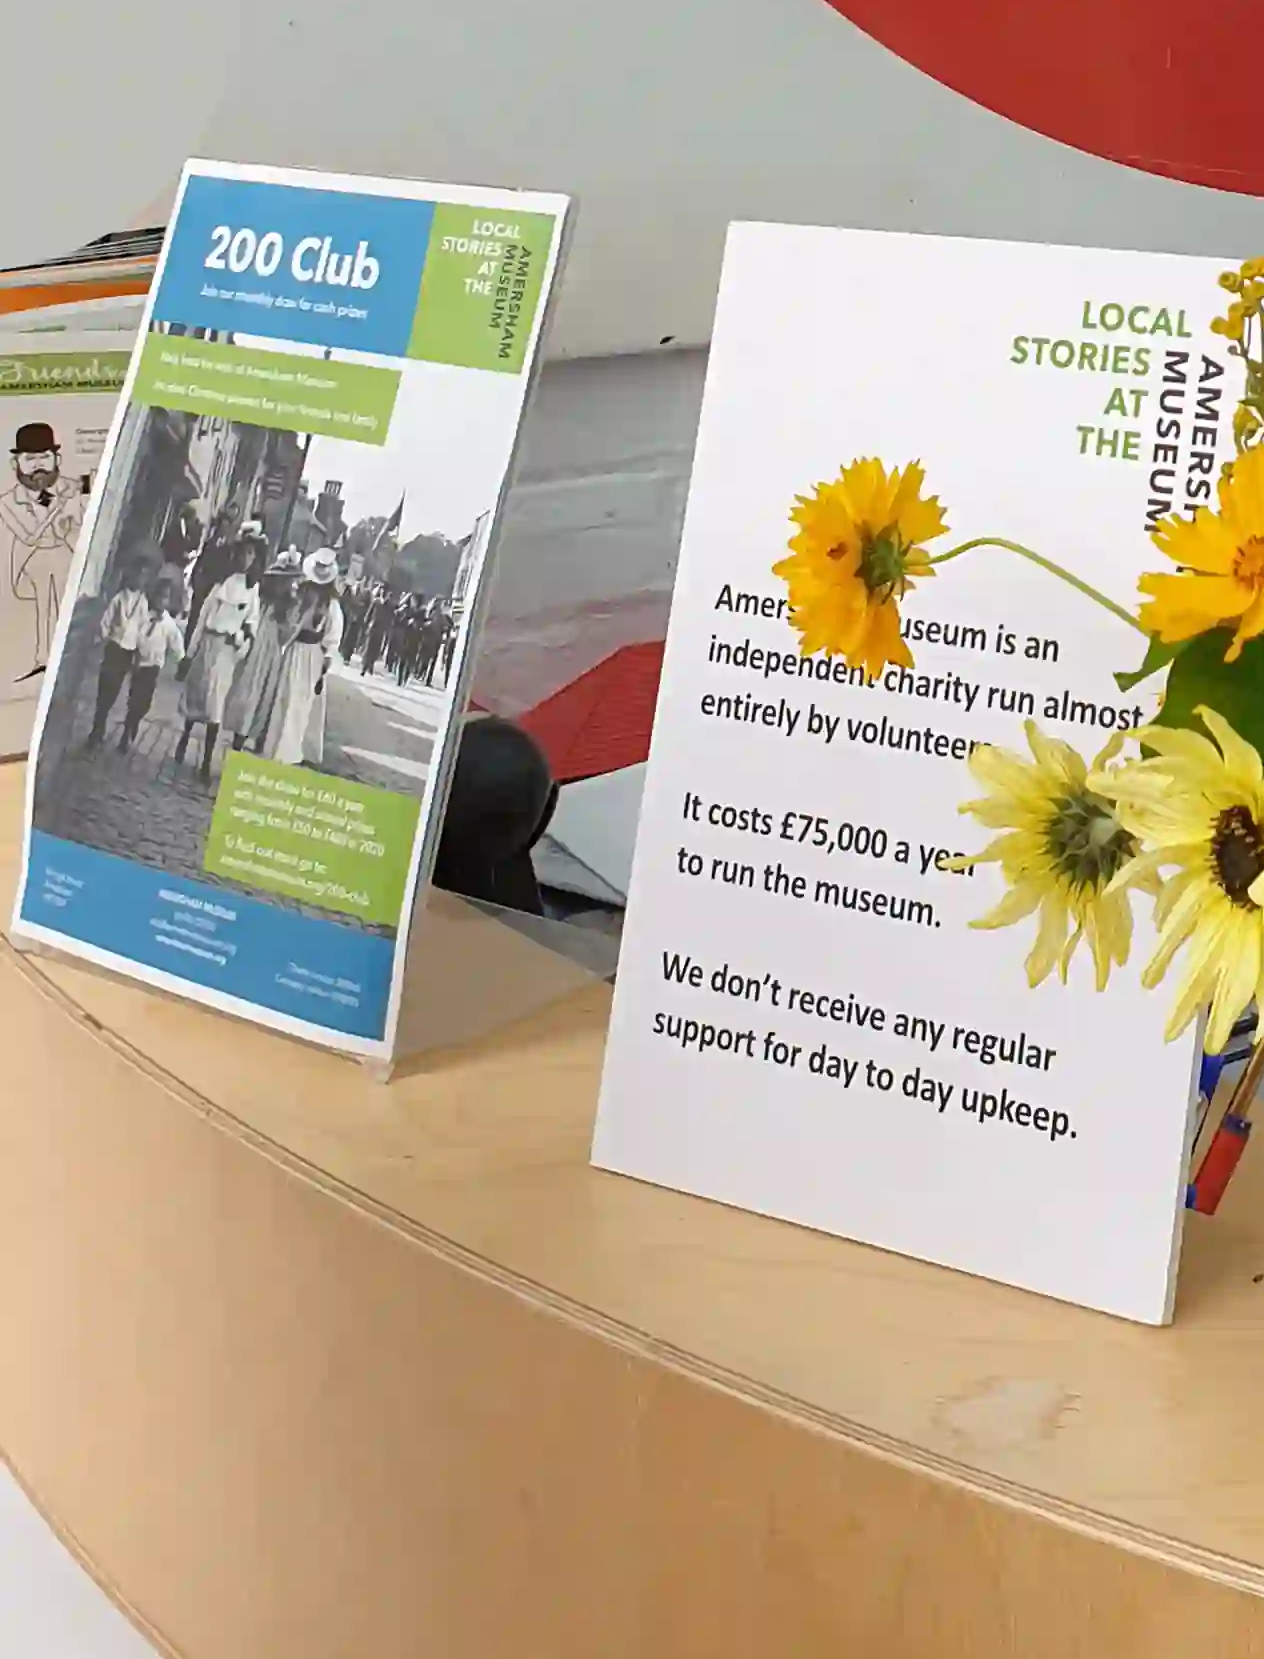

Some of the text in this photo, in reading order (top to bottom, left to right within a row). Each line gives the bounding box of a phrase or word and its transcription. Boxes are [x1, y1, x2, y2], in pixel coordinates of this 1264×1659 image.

[204, 225, 380, 290] 200 Club
[441, 236, 503, 257] STORIES
[472, 219, 521, 239] LOCAL
[462, 278, 494, 295] THE
[477, 261, 499, 276] AT
[488, 244, 518, 329] MUSEUM
[498, 245, 533, 359] AMERSHAM
[1081, 300, 1193, 338] LOCAL
[1010, 335, 1152, 376] STORIES
[1103, 388, 1149, 418] AT
[1076, 425, 1141, 460] THE
[1144, 349, 1190, 532] MUSEUM
[1183, 353, 1225, 525] AMERS
[714, 583, 1060, 662] Amer useum is an
[700, 691, 993, 760] entirely by volunteer
[883, 661, 981, 713] charity
[987, 684, 1036, 716] run
[1043, 690, 1145, 731] almost
[682, 791, 702, 822] It
[708, 803, 773, 836] costs
[779, 811, 888, 859] £75,000
[894, 840, 911, 864] a
[677, 847, 942, 928] to run the museum.
[662, 951, 1057, 1072] We don’t receive any regular
[653, 1009, 1078, 1142] support for day to day upkeep.
